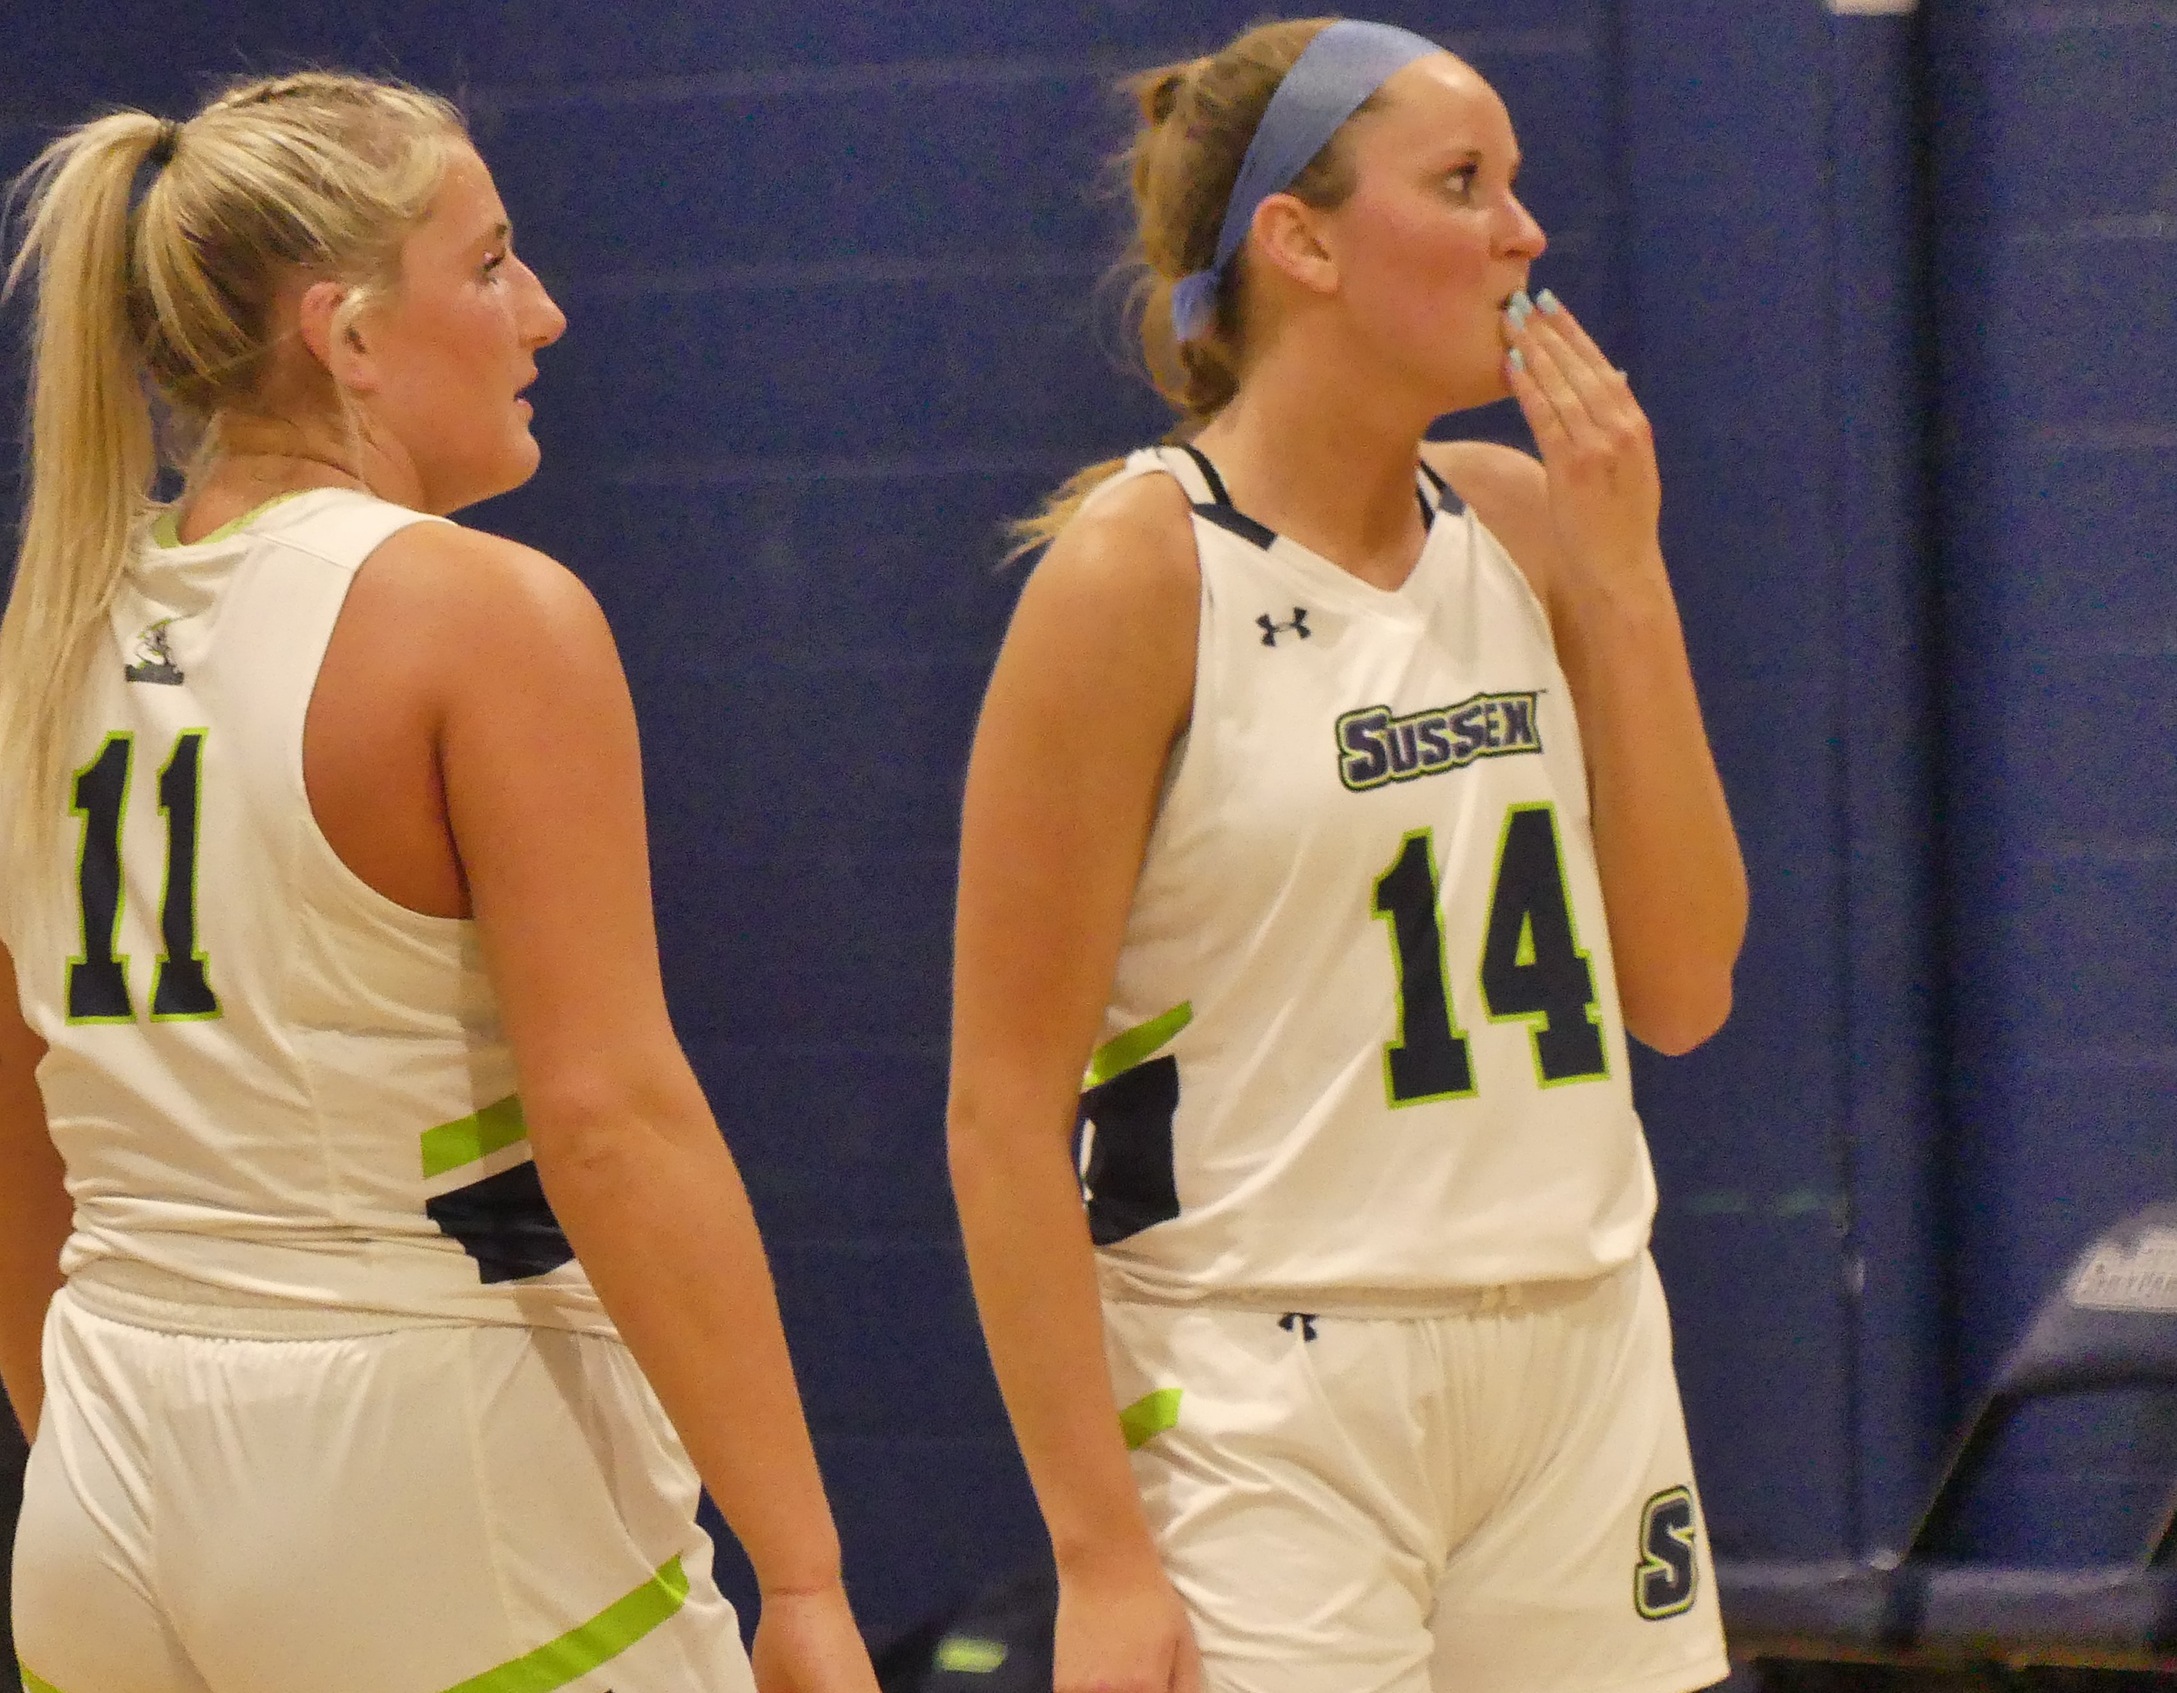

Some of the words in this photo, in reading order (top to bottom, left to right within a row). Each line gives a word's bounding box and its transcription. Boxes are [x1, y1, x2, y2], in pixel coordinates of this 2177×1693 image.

[1337, 693, 1540, 791] SUSSEX
[65, 728, 223, 1025] 11
[1371, 801, 1611, 1109] 14
[1635, 1485, 1698, 1620] S
